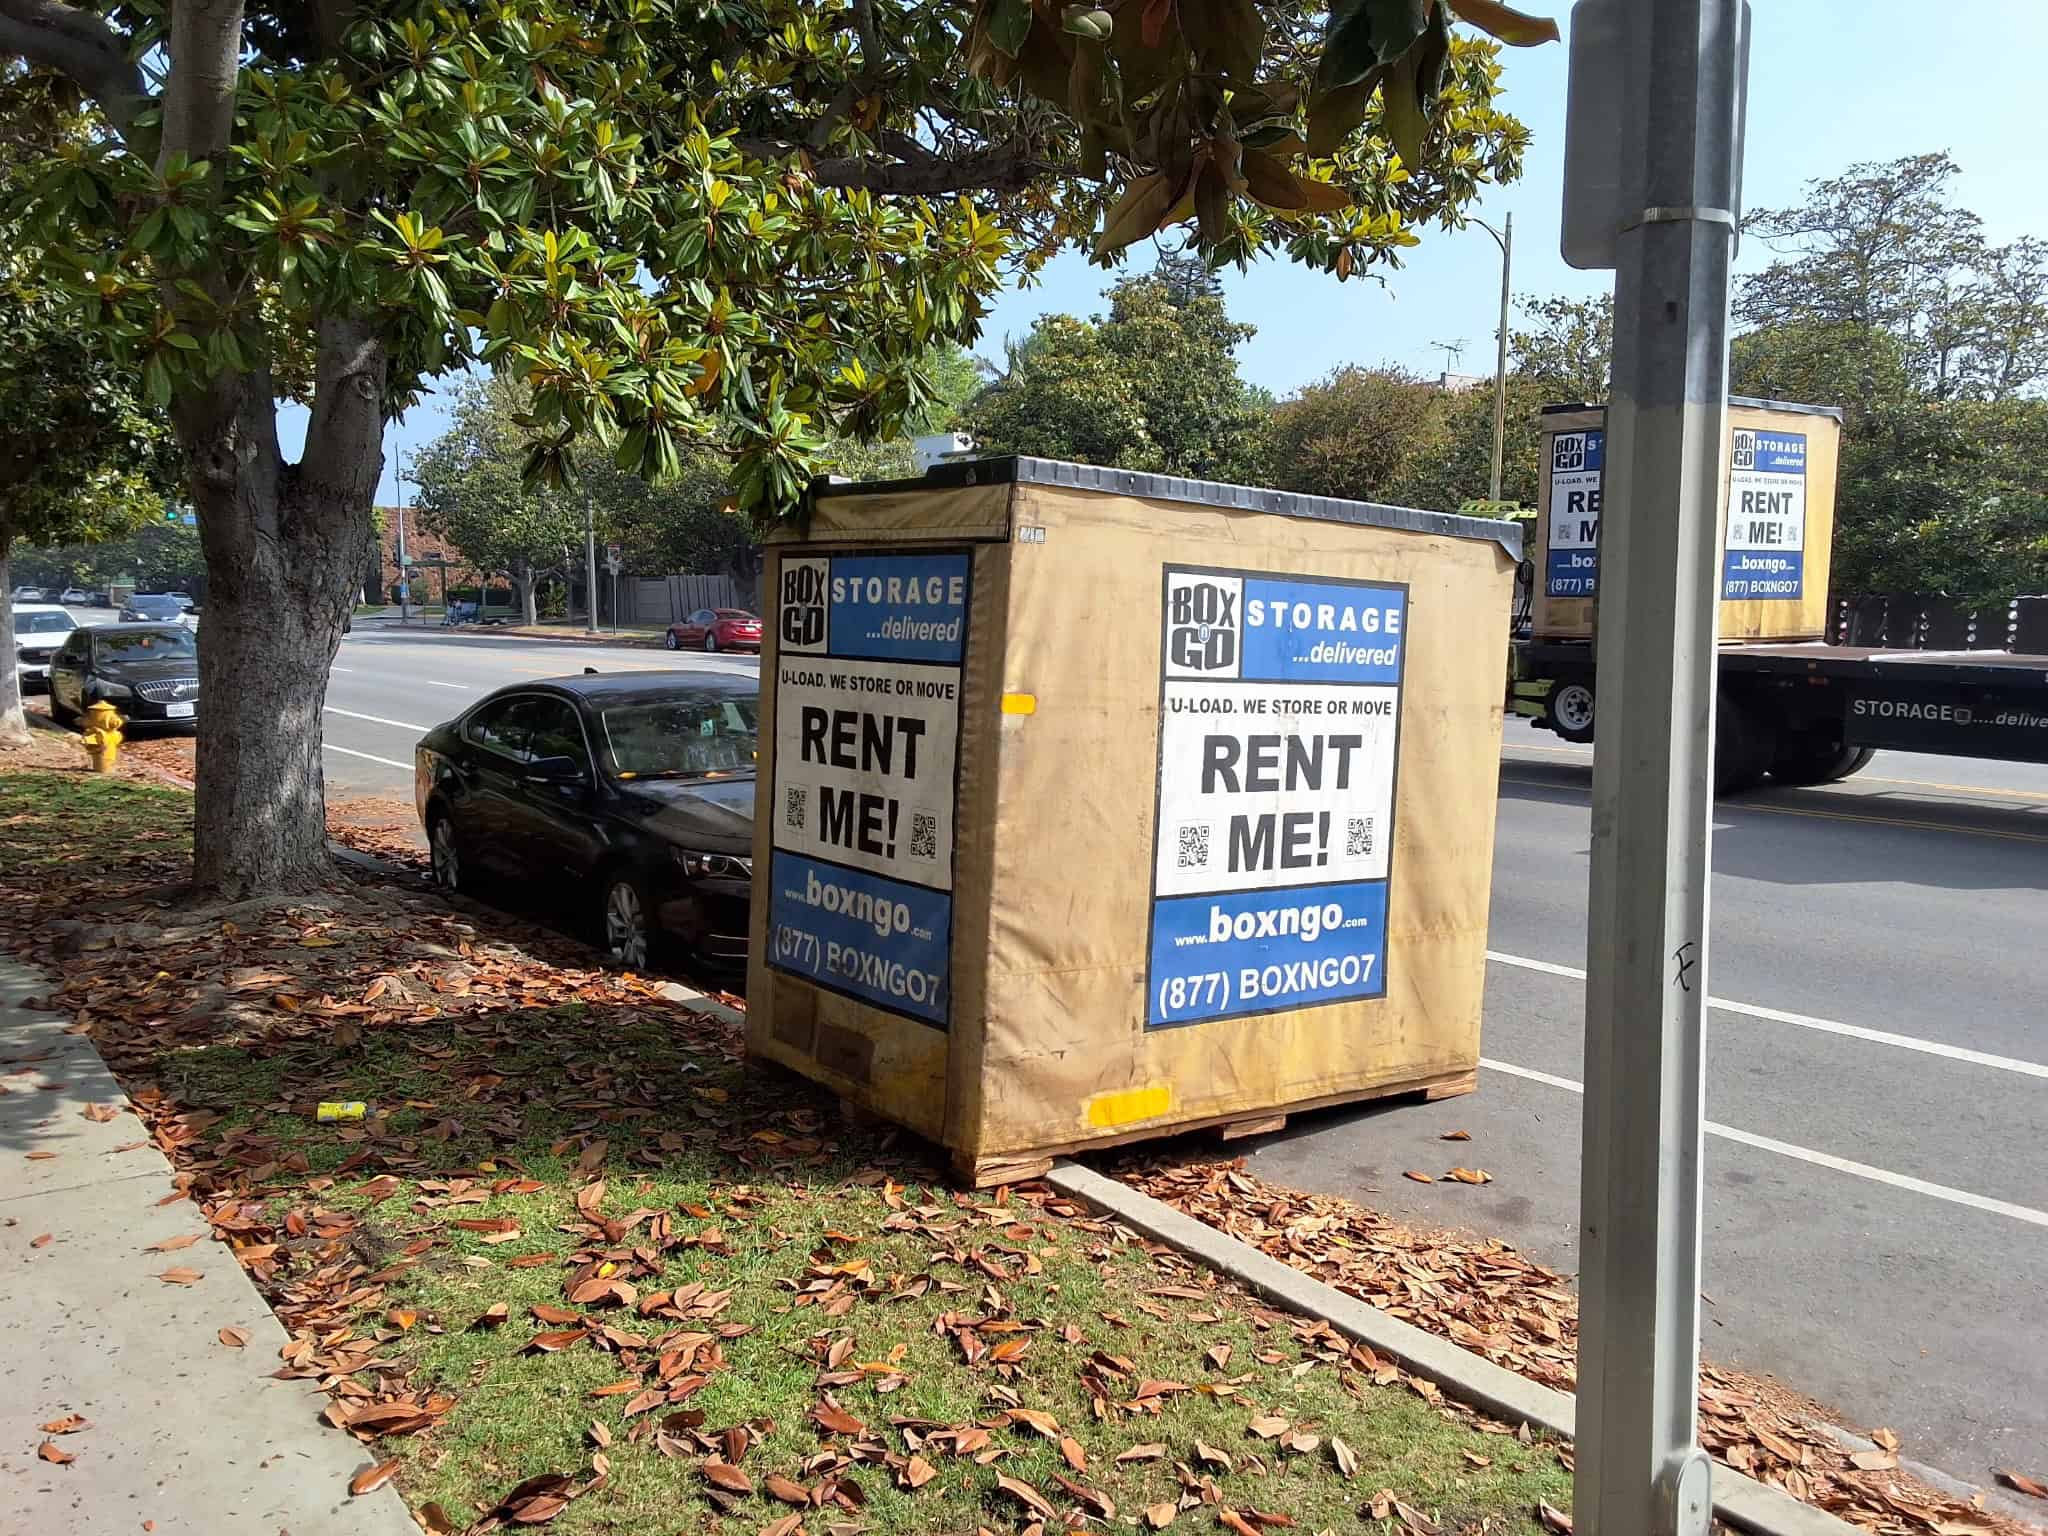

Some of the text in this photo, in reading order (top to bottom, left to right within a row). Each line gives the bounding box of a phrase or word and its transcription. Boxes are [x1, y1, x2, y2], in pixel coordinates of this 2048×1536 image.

[1556, 437, 1583, 453] BOX
[1735, 434, 1753, 450] BOX
[1756, 439, 1805, 454] STORAGE
[1568, 490, 1600, 513] RE
[1741, 490, 1793, 514] RENT
[1749, 521, 1783, 544] ME!
[784, 564, 824, 606] BOX
[832, 576, 964, 605] STORAGE
[1551, 577, 1581, 593] (877)
[1726, 580, 1798, 597] (877) BOXNGO7
[1172, 582, 1236, 627] BOX
[1247, 600, 1400, 634] STORAGE
[782, 606, 824, 646] GO
[866, 616, 960, 641] ...delivered
[1171, 627, 1235, 671] GO
[1292, 641, 1397, 666] ...delivered
[782, 669, 954, 700] U-LOAD. WE STORE OR MOVE
[1171, 698, 1392, 716] U-LOAD. WE STORE OR MOVE
[1854, 699, 1952, 721] STORAGE
[801, 705, 926, 780] RENT
[1201, 734, 1363, 794] RENT
[819, 786, 899, 859] ME!
[1227, 811, 1331, 873] ME!
[1174, 903, 1368, 947] www.boxngo.com
[775, 924, 941, 1006] (877) BOXNGO7
[1159, 953, 1376, 1019] (877) BOXNGO7
